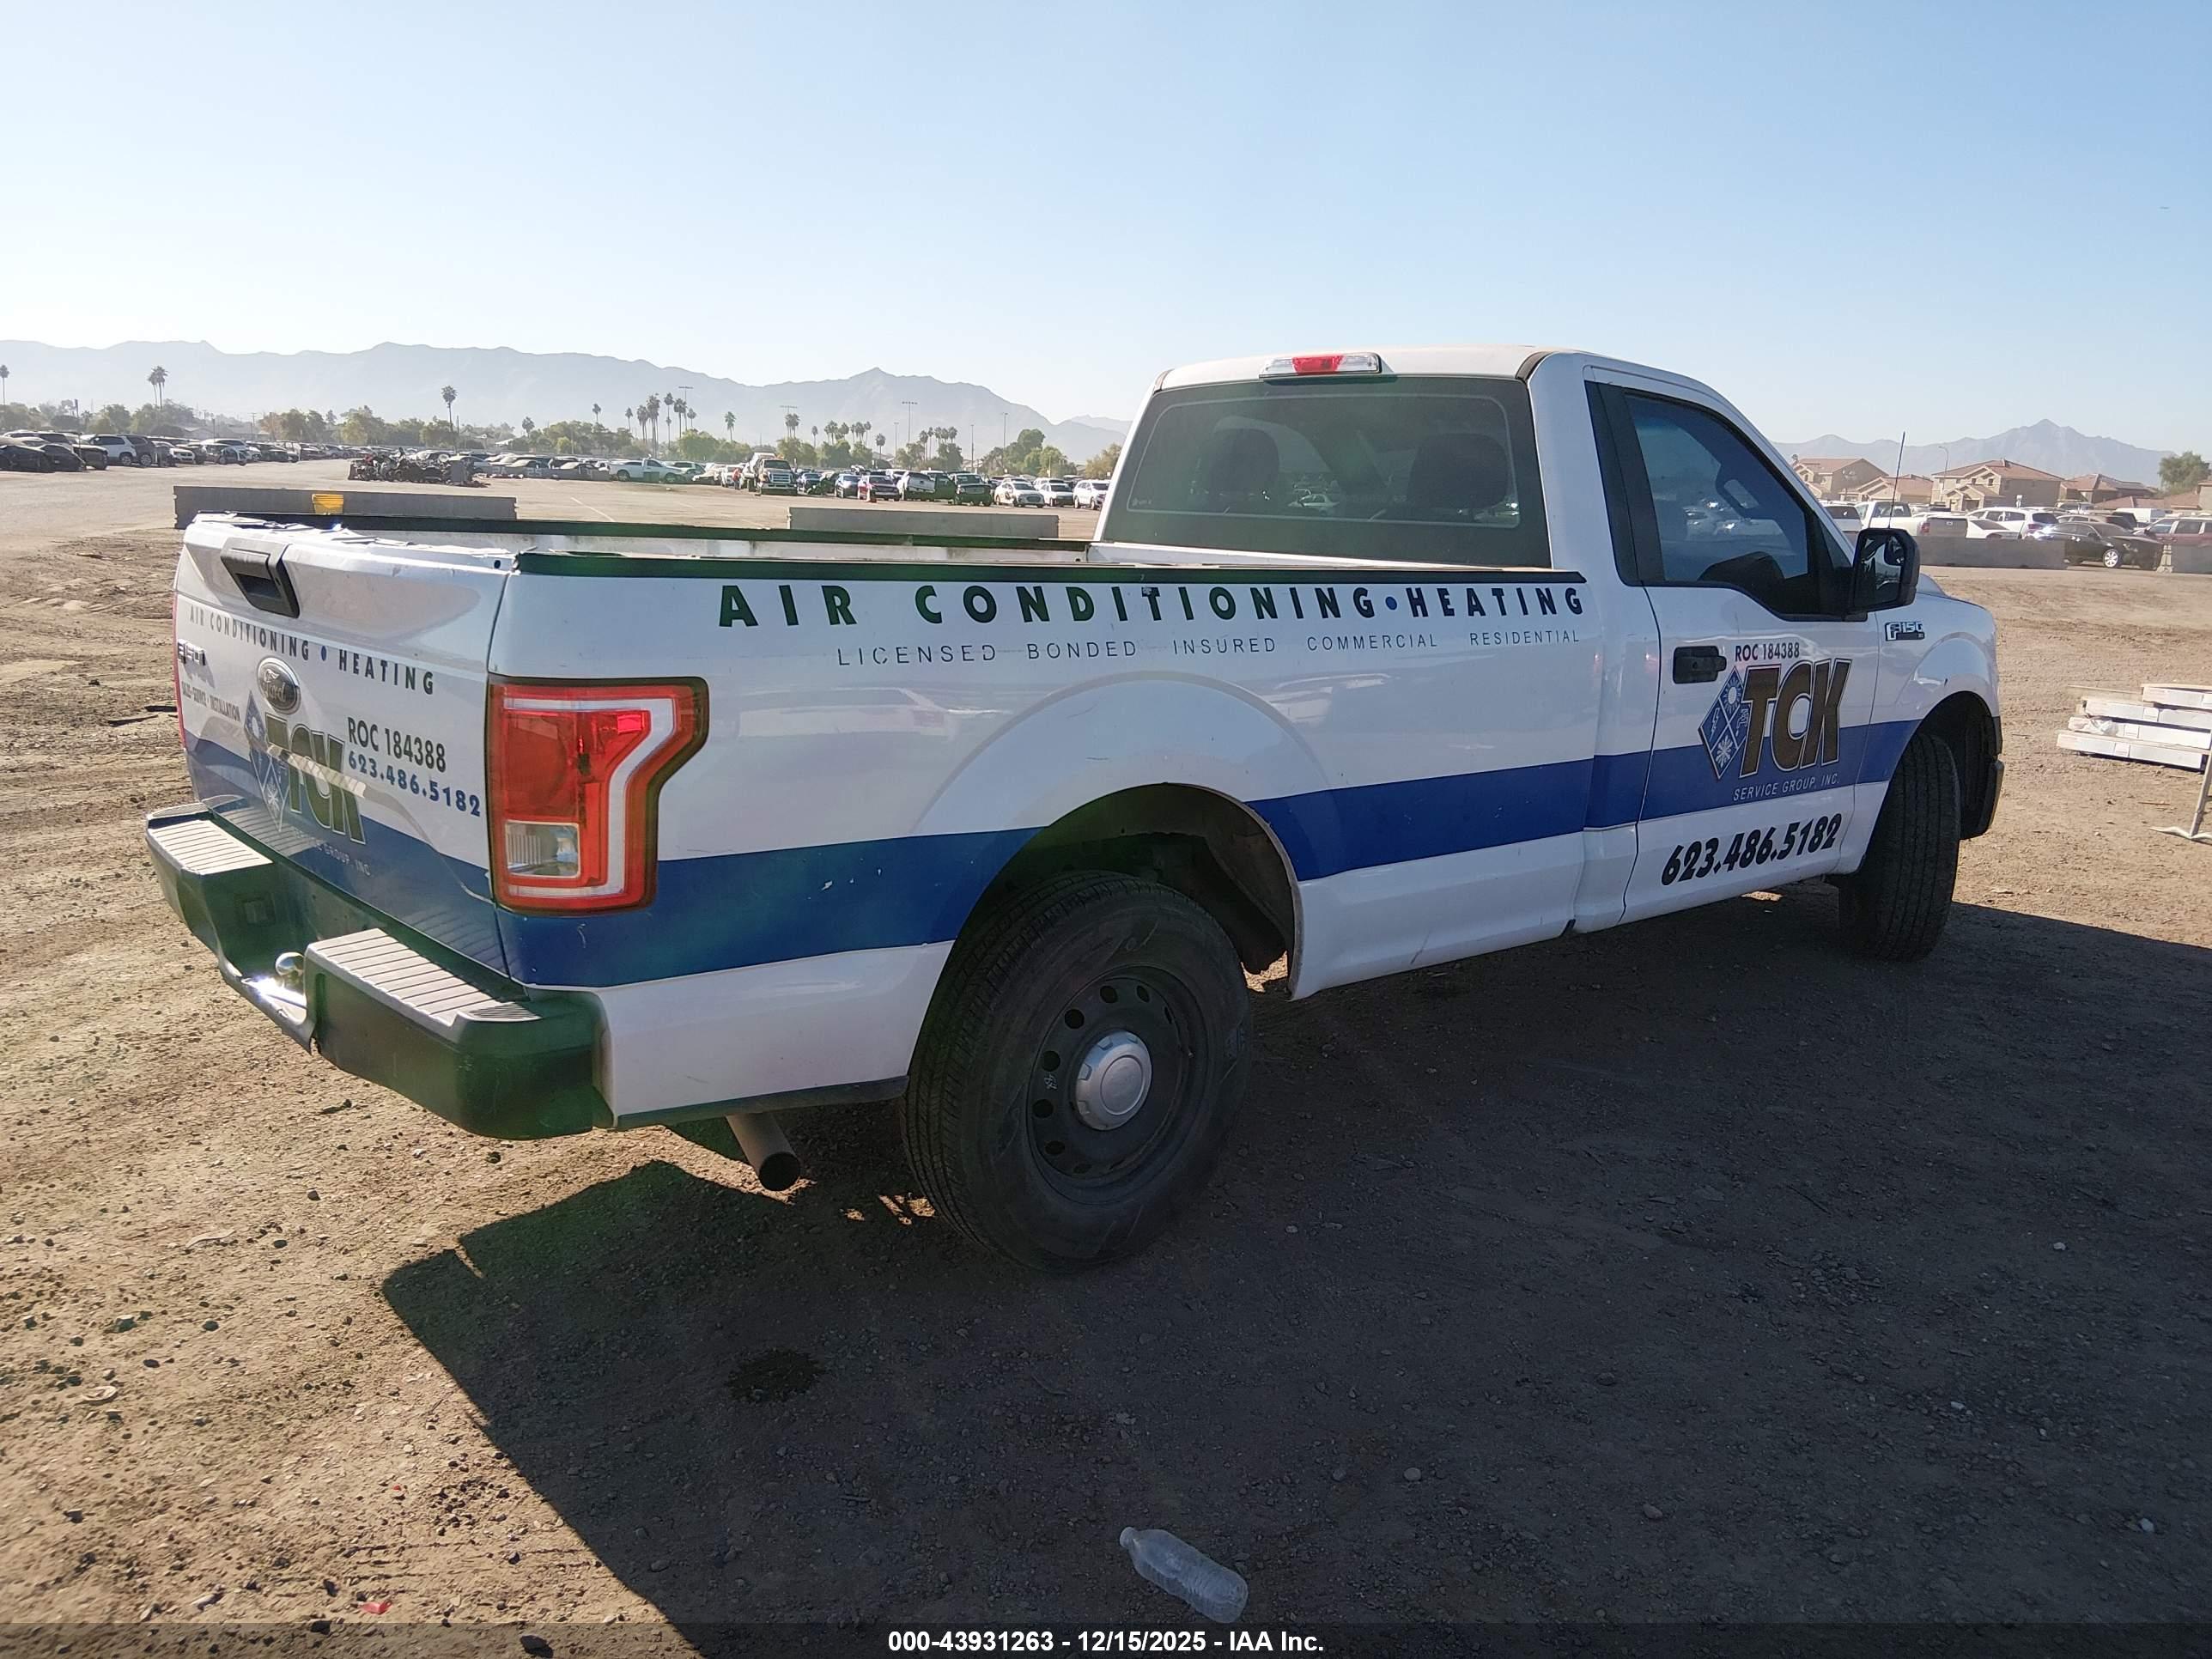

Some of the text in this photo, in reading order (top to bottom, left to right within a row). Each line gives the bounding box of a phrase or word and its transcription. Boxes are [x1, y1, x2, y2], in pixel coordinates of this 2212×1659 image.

[719, 584, 1583, 628] AIR CONDITIONING HEATING
[189, 605, 434, 695] AIR CONDITIONING HEATING
[837, 629, 1581, 666] LICENSED BONDED INSURED COMMERCIAL RESIDENTIAL
[1735, 641, 1800, 663] ROC 184388
[348, 716, 446, 773] ROC 184388
[1739, 658, 1852, 778] TCK
[264, 712, 366, 845] TCK
[348, 750, 481, 817] 623.486.5182
[1733, 781, 1779, 801] SERVICE
[1820, 773, 1840, 787] INC.
[1661, 812, 1843, 886] 623.486.5182
